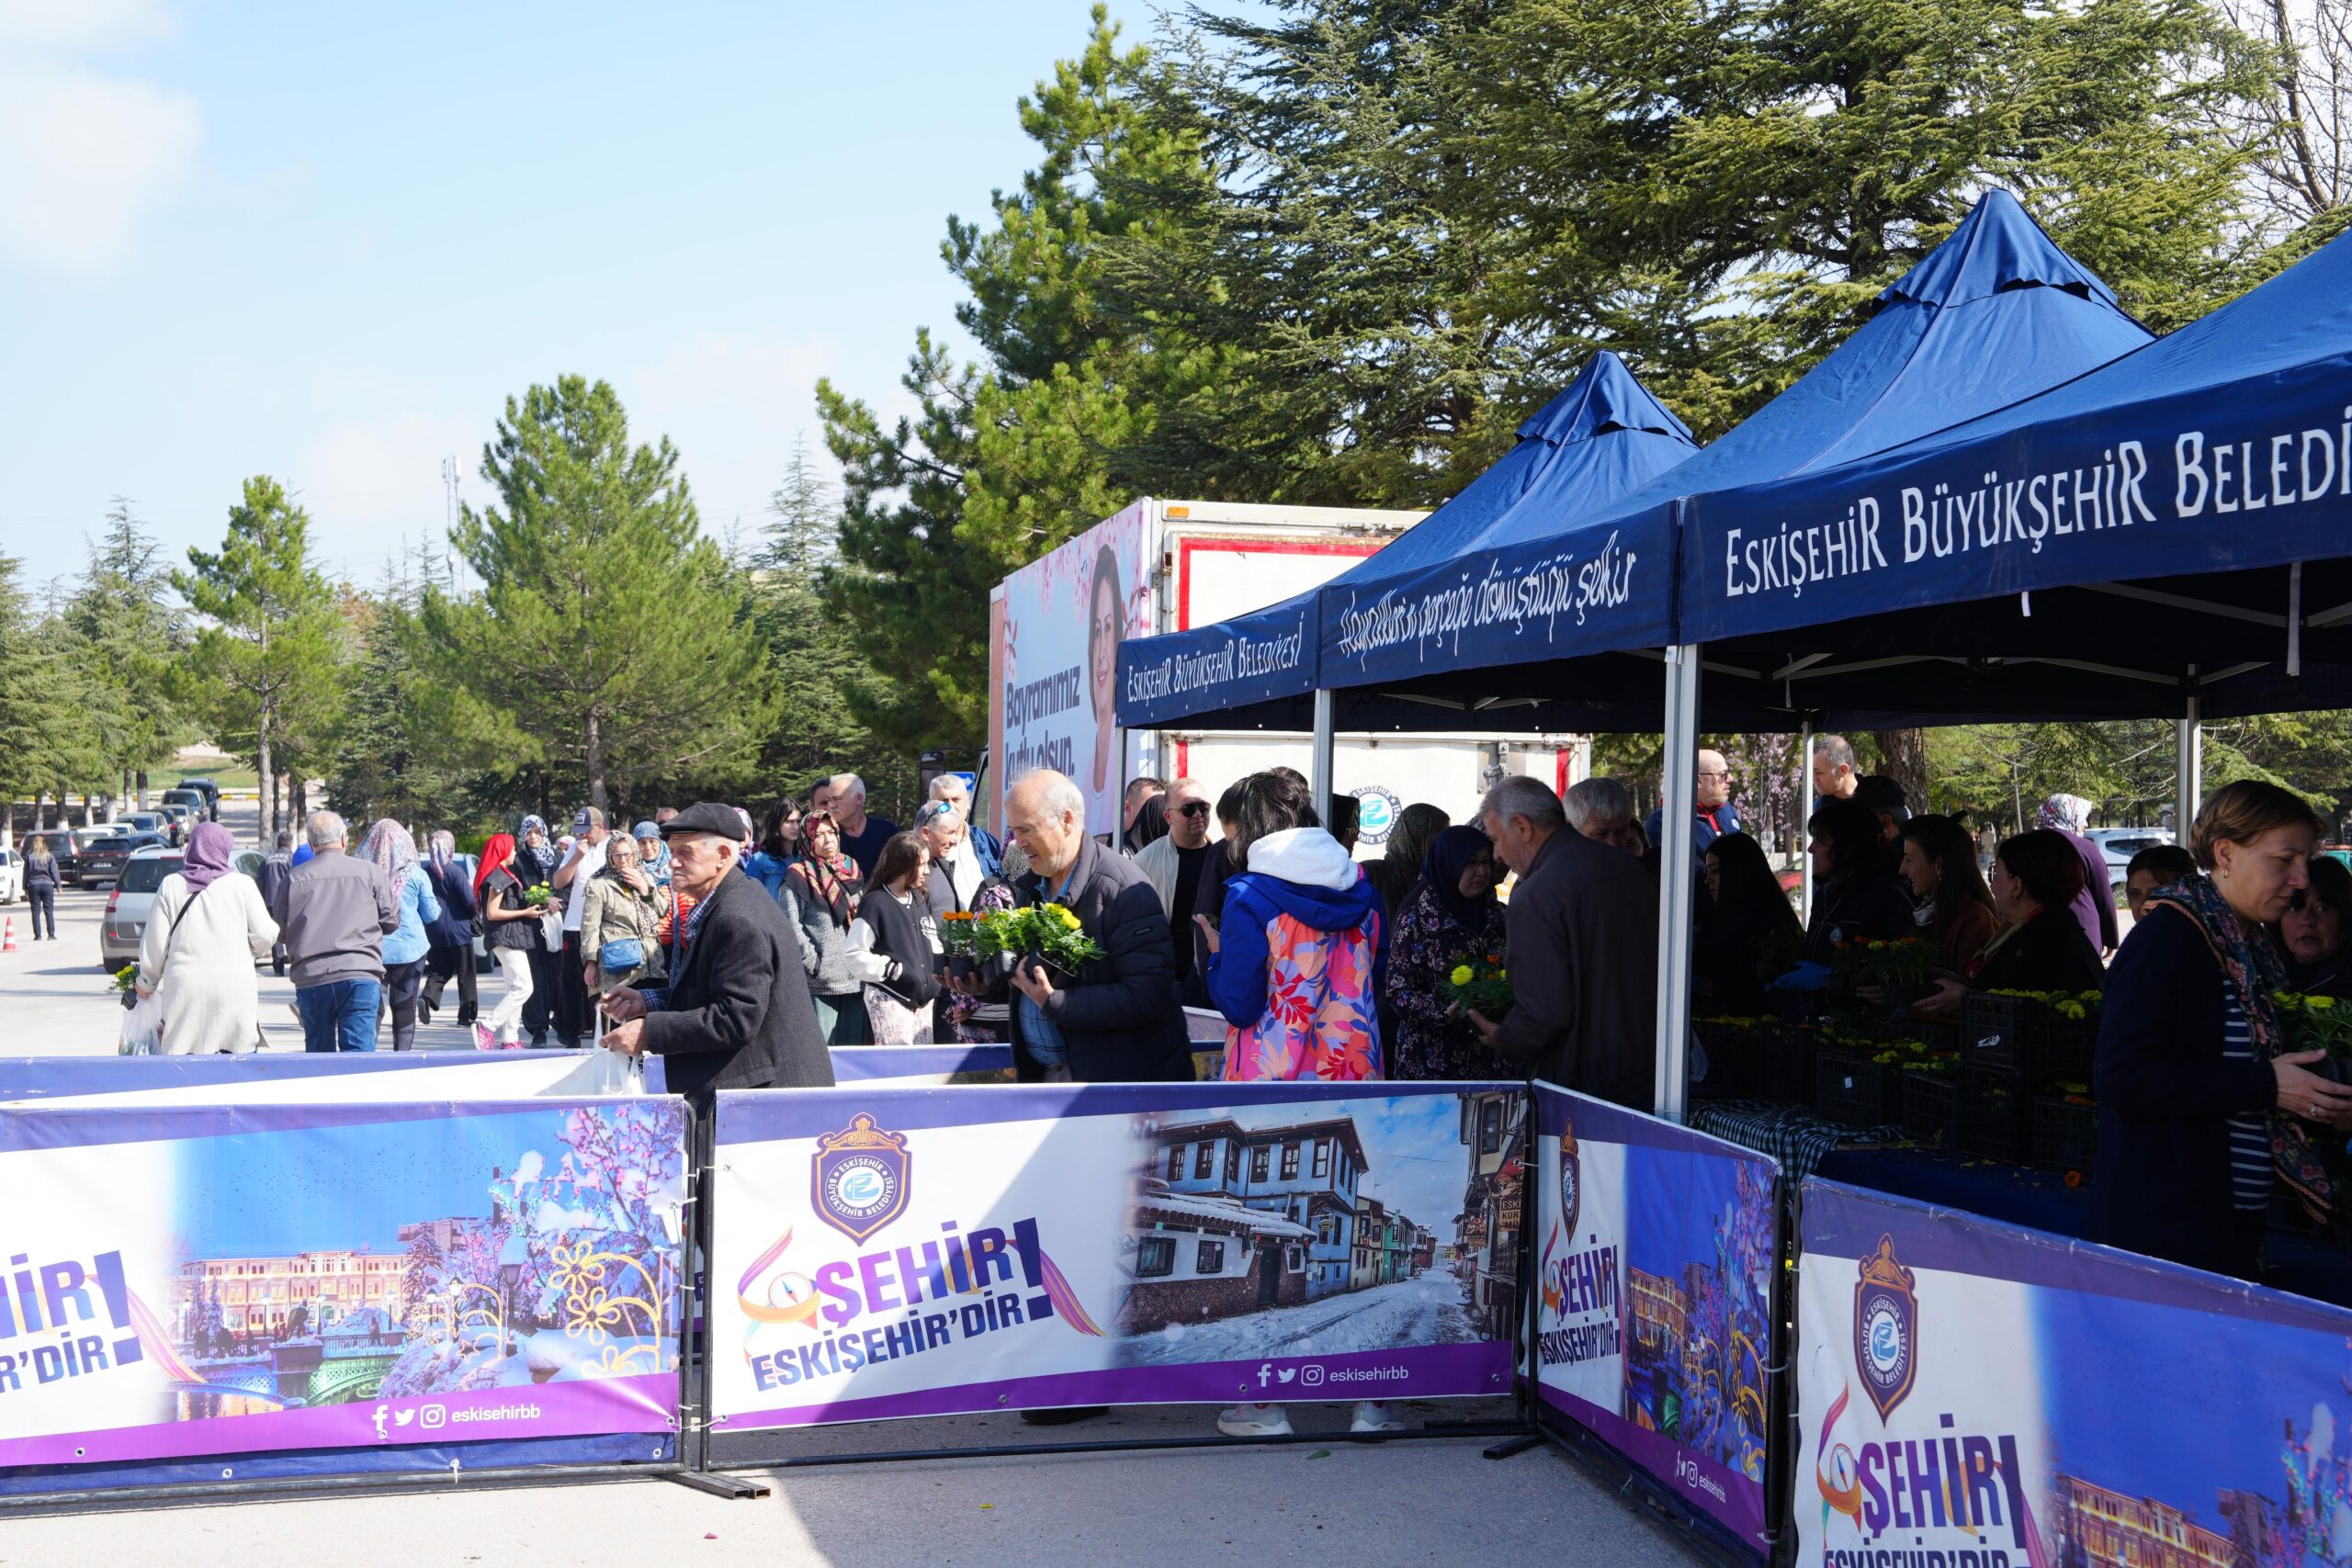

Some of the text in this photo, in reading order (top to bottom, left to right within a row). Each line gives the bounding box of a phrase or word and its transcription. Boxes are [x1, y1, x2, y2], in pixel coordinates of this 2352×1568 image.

[1726, 497, 1888, 598] ESKİŞEHİR
[1901, 440, 2157, 554] BÜYÜKŞEHİR
[1576, 530, 1636, 626] şehir
[1127, 611, 1305, 706] ESKİŞEHİR BÜYÜKŞEHİR BELEDİYESİ
[1006, 665, 1080, 736] Bayramımız
[837, 1156, 884, 1173] ESKİŞEHİR
[828, 1176, 894, 1217] BÜYÜKŞEHİR BELEDİYESİ
[1329, 1365, 1409, 1382] eskisehirbb
[451, 1403, 541, 1423] eskisehirbb
